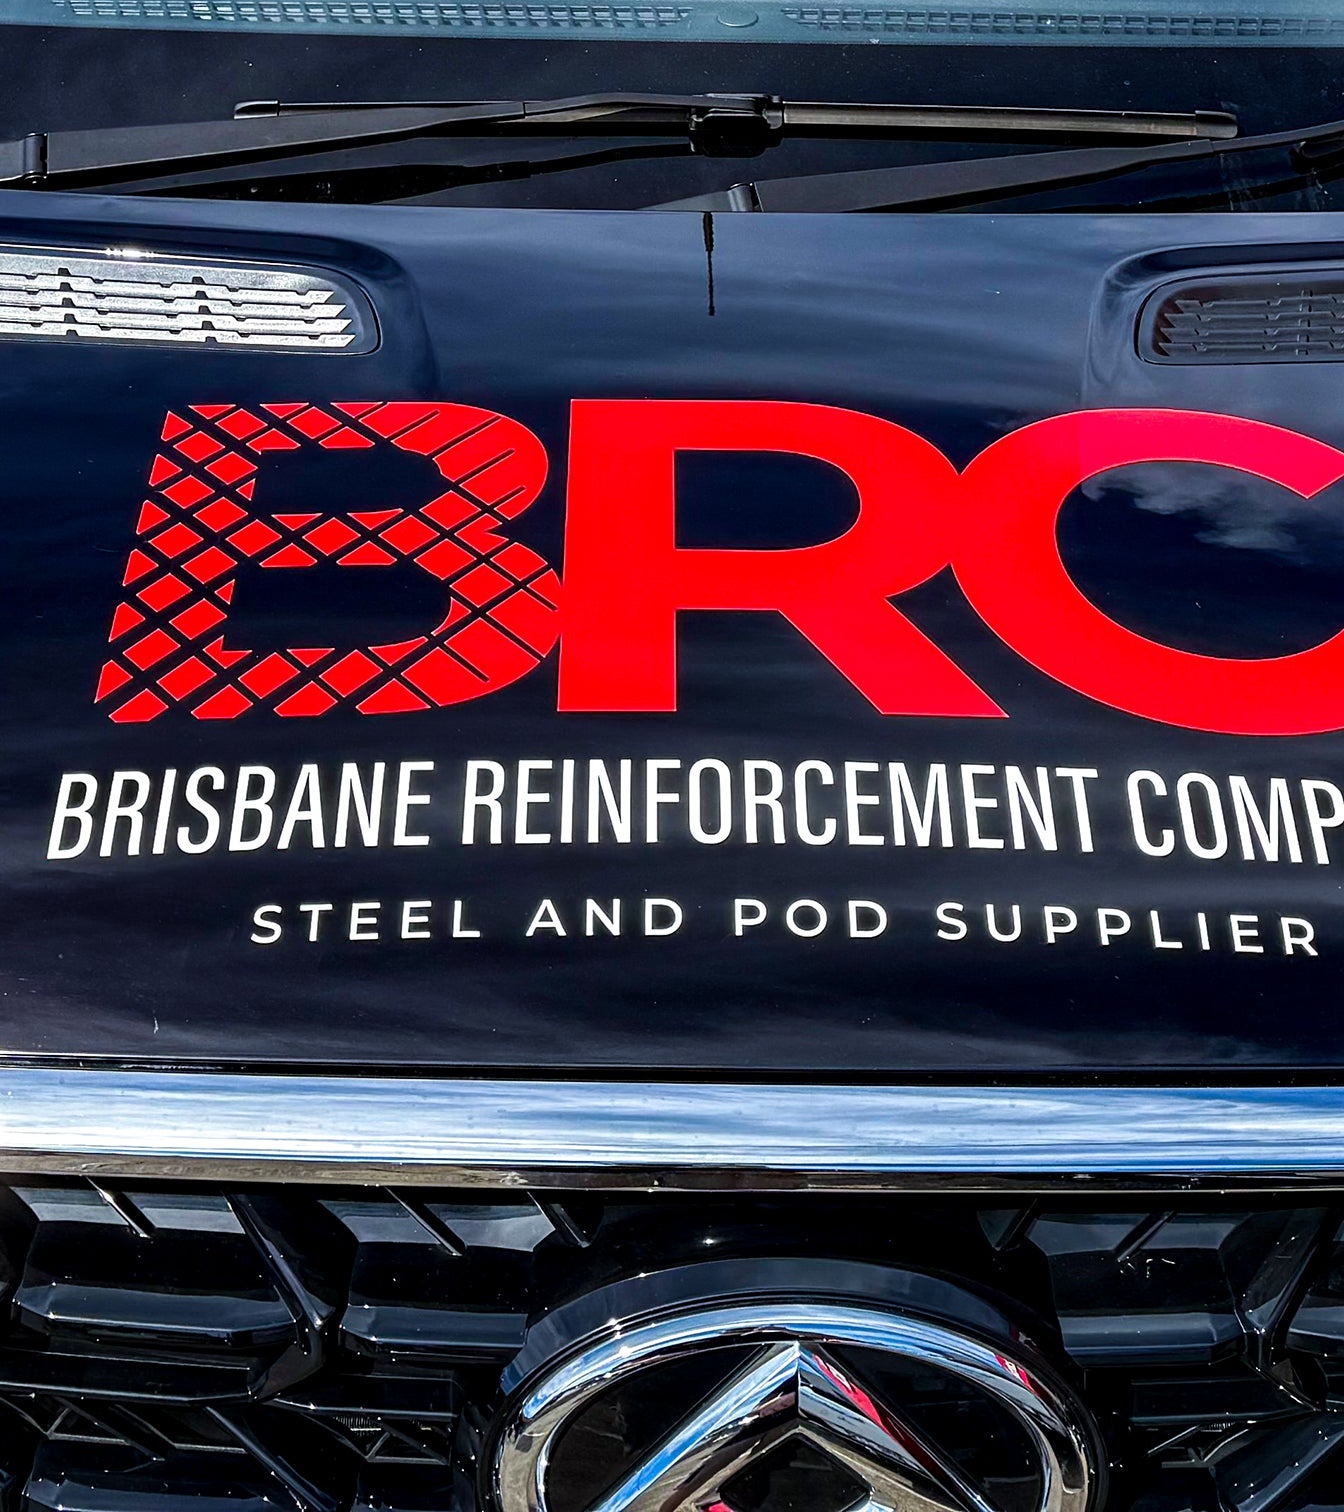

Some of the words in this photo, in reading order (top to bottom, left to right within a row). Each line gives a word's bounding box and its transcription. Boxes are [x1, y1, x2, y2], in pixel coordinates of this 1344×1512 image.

[47, 760, 435, 860] BRISBANE
[462, 758, 1099, 853] REINFORCEMENT
[250, 899, 481, 944] STEEL
[525, 898, 683, 939] AND
[734, 898, 888, 940] POD
[936, 902, 1319, 956] SUPPLIER
